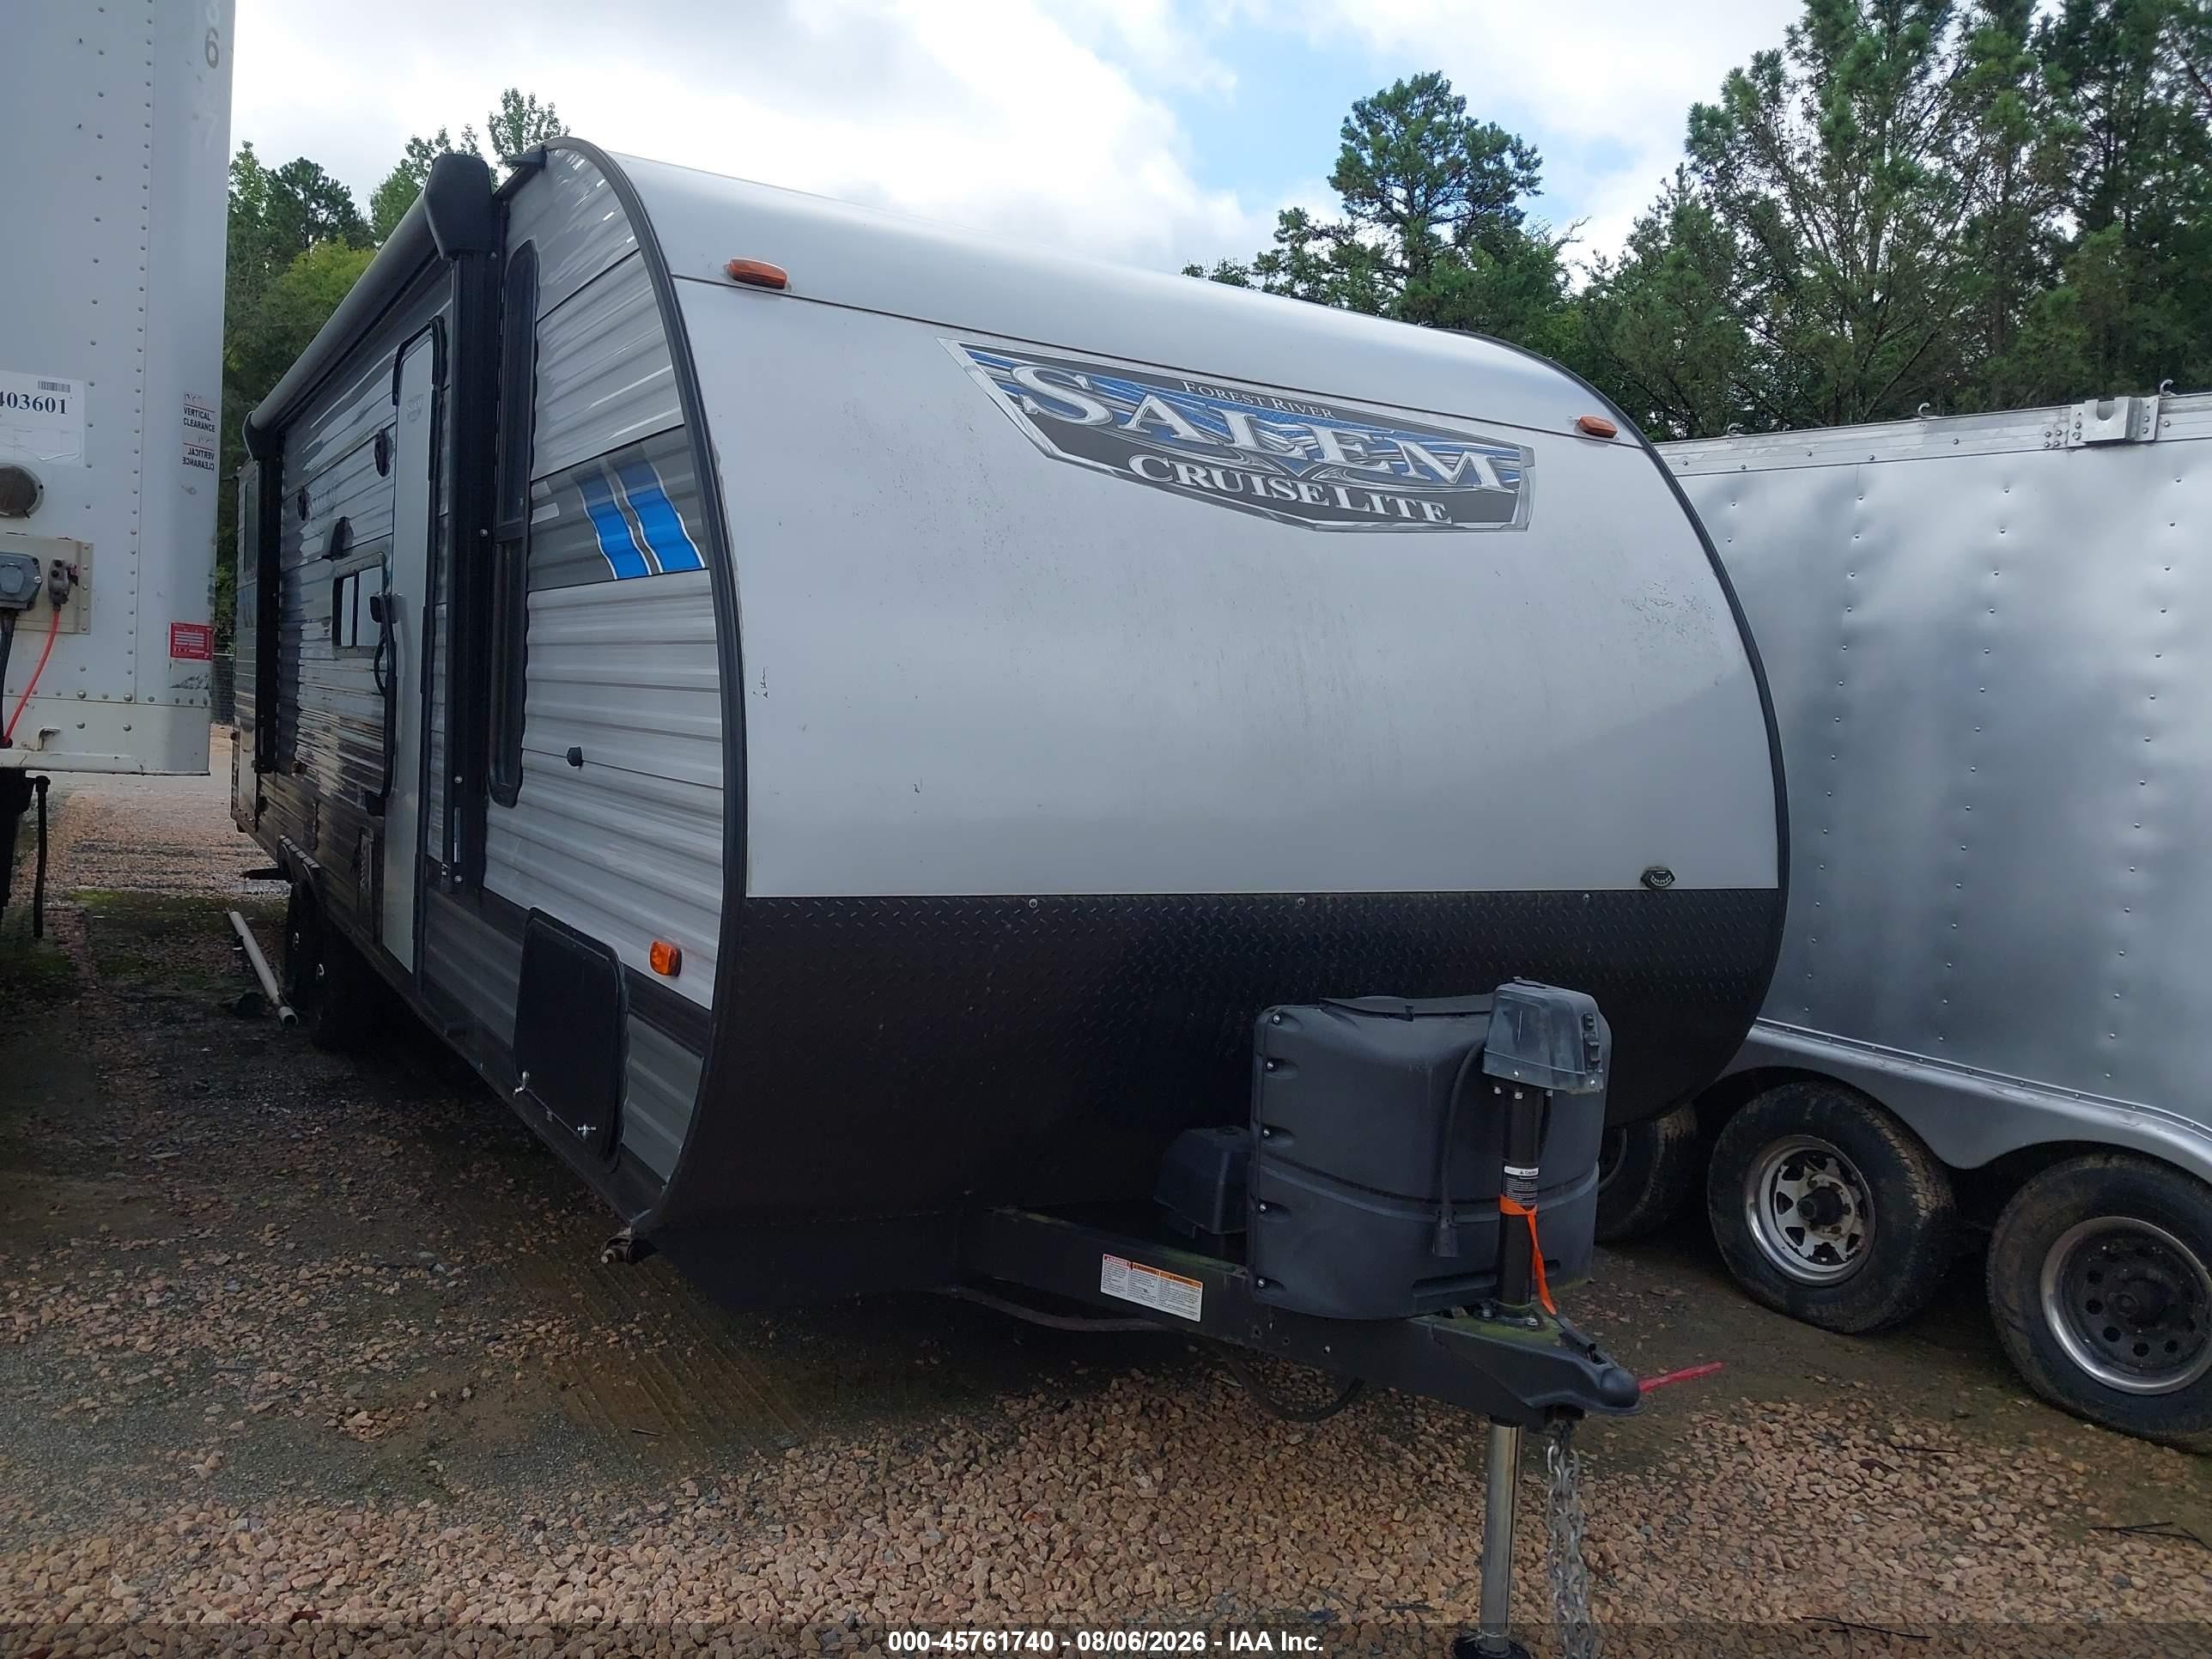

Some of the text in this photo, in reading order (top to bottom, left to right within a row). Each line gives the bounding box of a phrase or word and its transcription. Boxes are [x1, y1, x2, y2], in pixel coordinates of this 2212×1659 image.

[1181, 380, 1336, 419] FOREST RIVER
[183, 417, 216, 433] CLEARANCE
[184, 406, 211, 421] VERTICAL
[1010, 364, 1520, 494] SALEM
